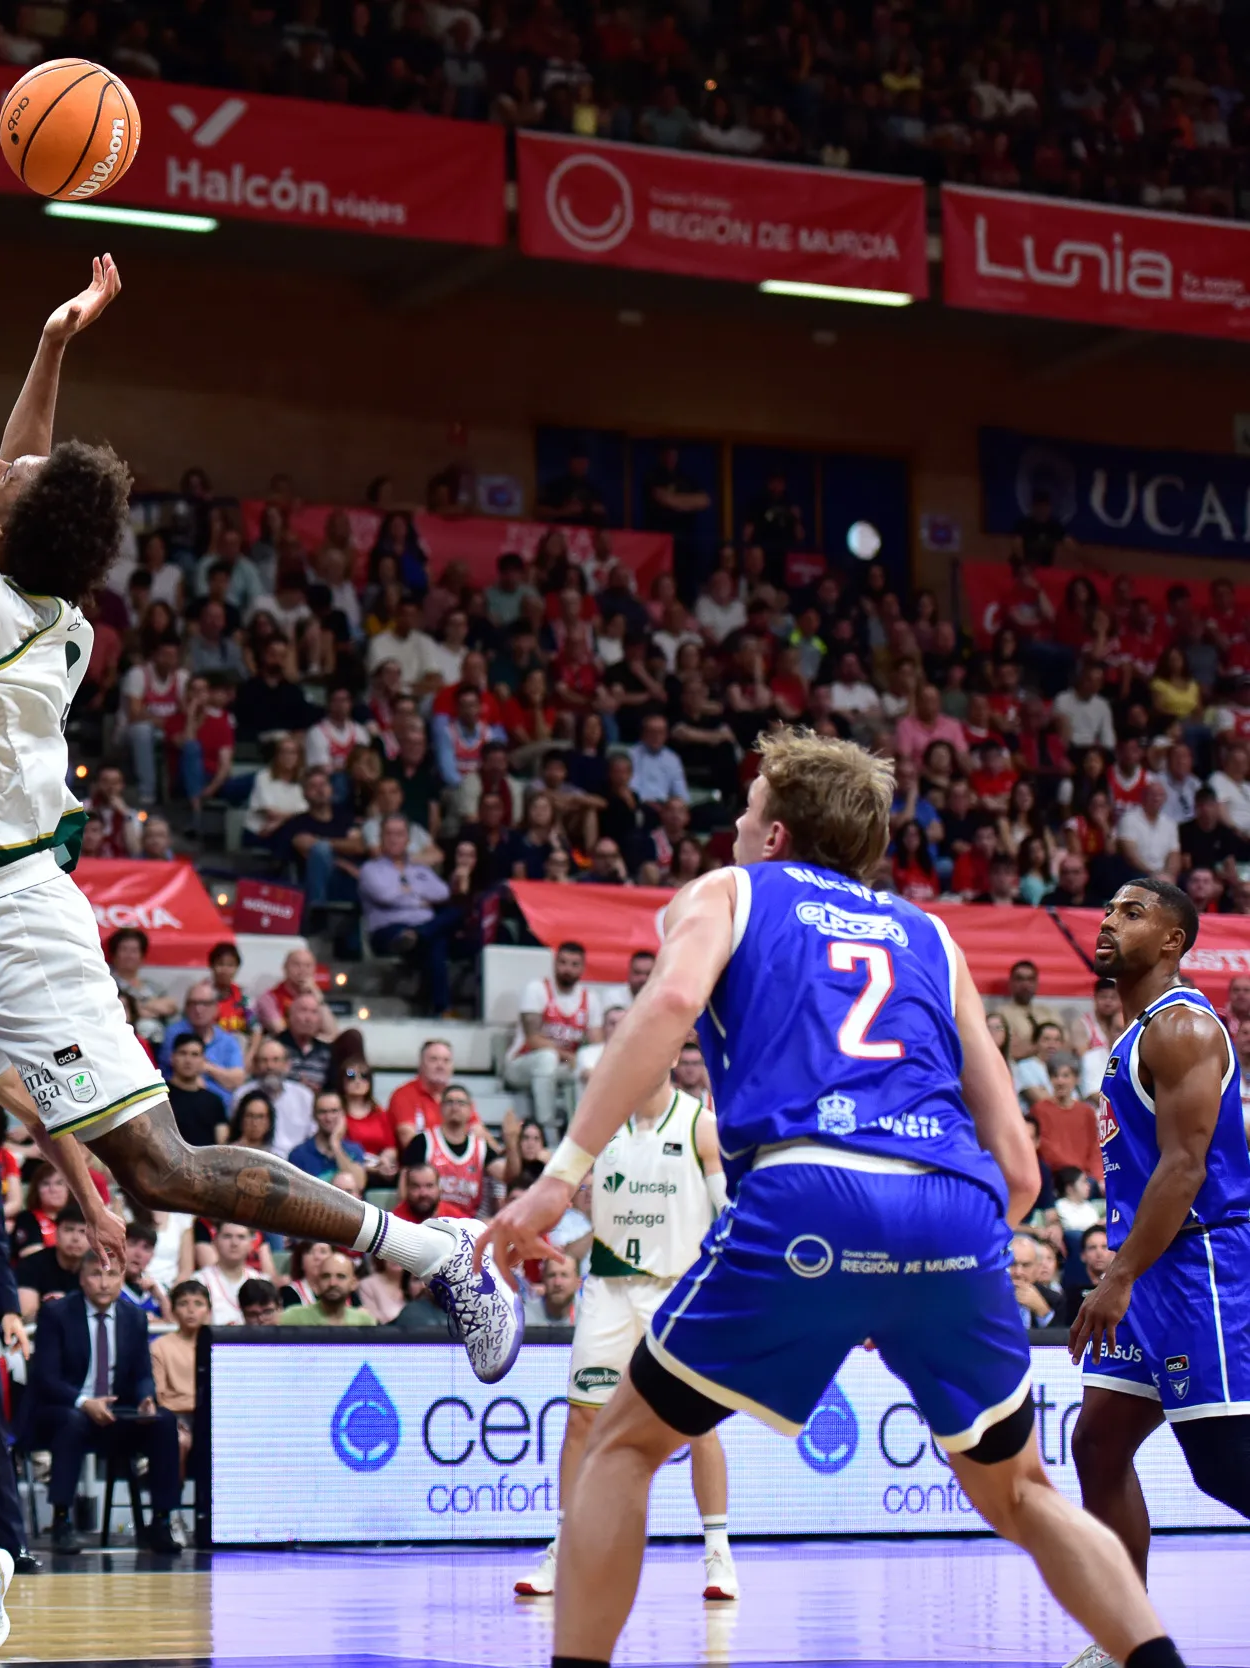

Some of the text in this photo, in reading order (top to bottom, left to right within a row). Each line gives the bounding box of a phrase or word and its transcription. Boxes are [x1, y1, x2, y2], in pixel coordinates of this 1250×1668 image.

[68, 118, 125, 197] Wilson
[166, 155, 407, 227] Halcón viajes
[756, 220, 794, 253] DE
[797, 226, 901, 261] MURCIA
[974, 213, 1173, 300] Lunia
[1090, 467, 1250, 542] UCA
[828, 941, 905, 1060] 2
[58, 1052, 77, 1065] acb
[625, 1238, 642, 1266] 4
[840, 1259, 899, 1274] REGIÓN
[925, 1255, 978, 1272] MURCIA
[426, 1474, 553, 1514] confort
